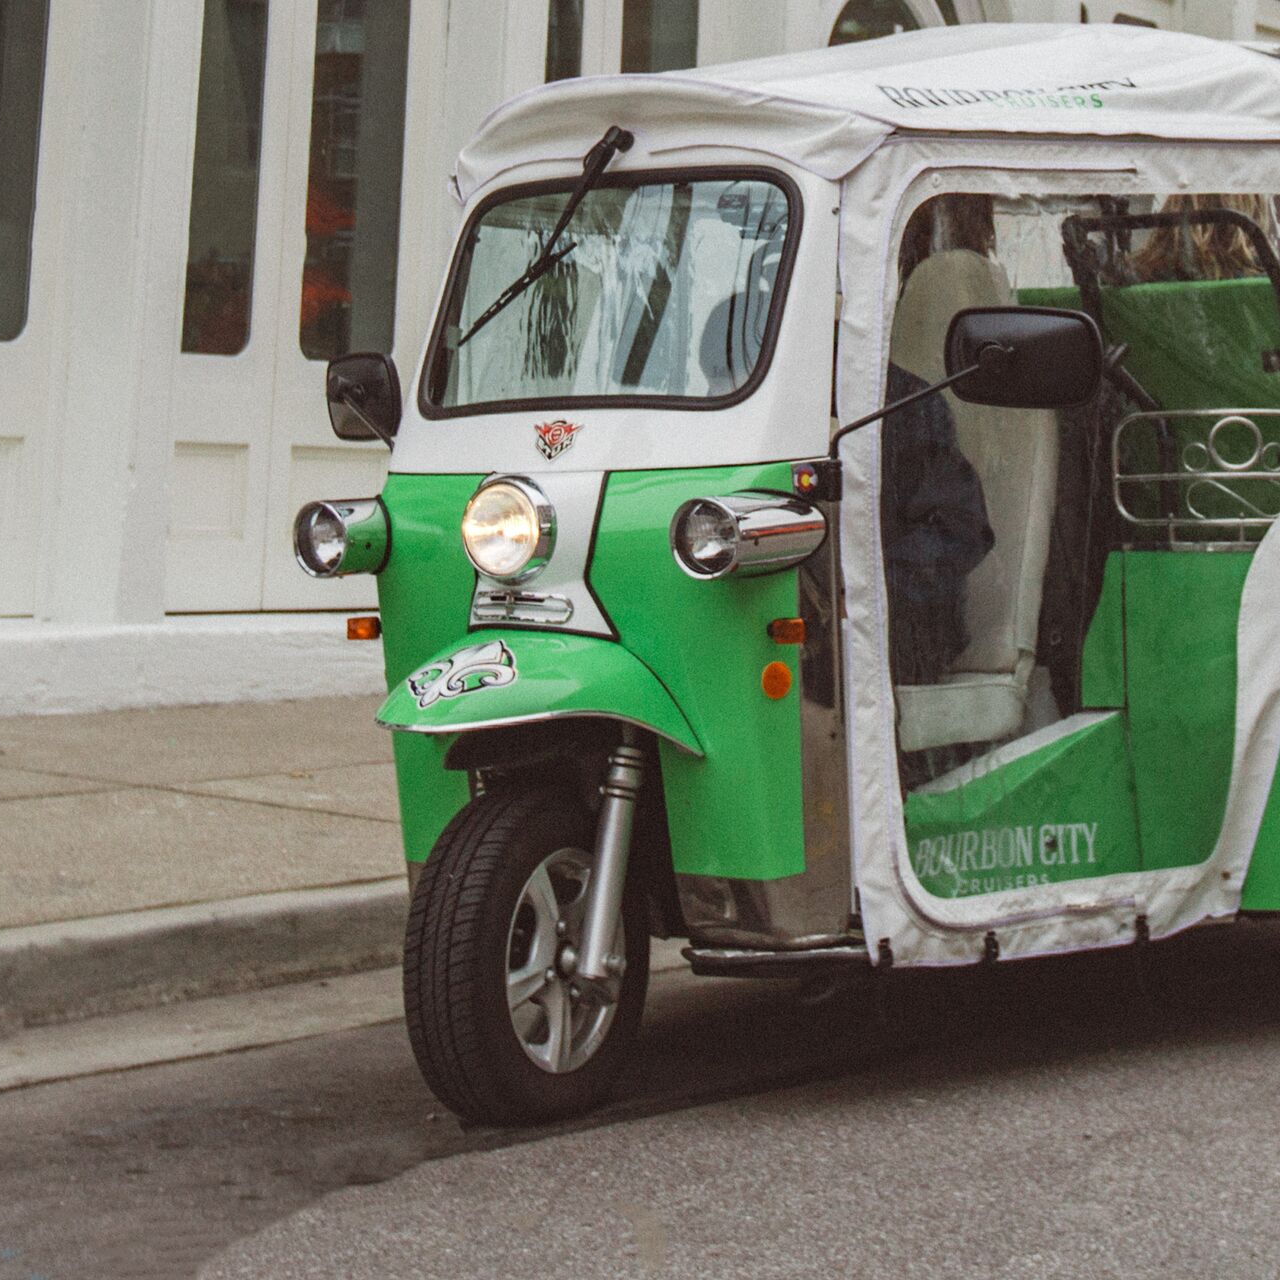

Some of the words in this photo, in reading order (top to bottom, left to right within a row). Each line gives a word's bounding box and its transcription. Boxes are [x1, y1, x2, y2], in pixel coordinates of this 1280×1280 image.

[914, 825, 1033, 878] BOURBON
[1039, 822, 1098, 866] CITY
[957, 873, 1050, 894] CRUISERS
